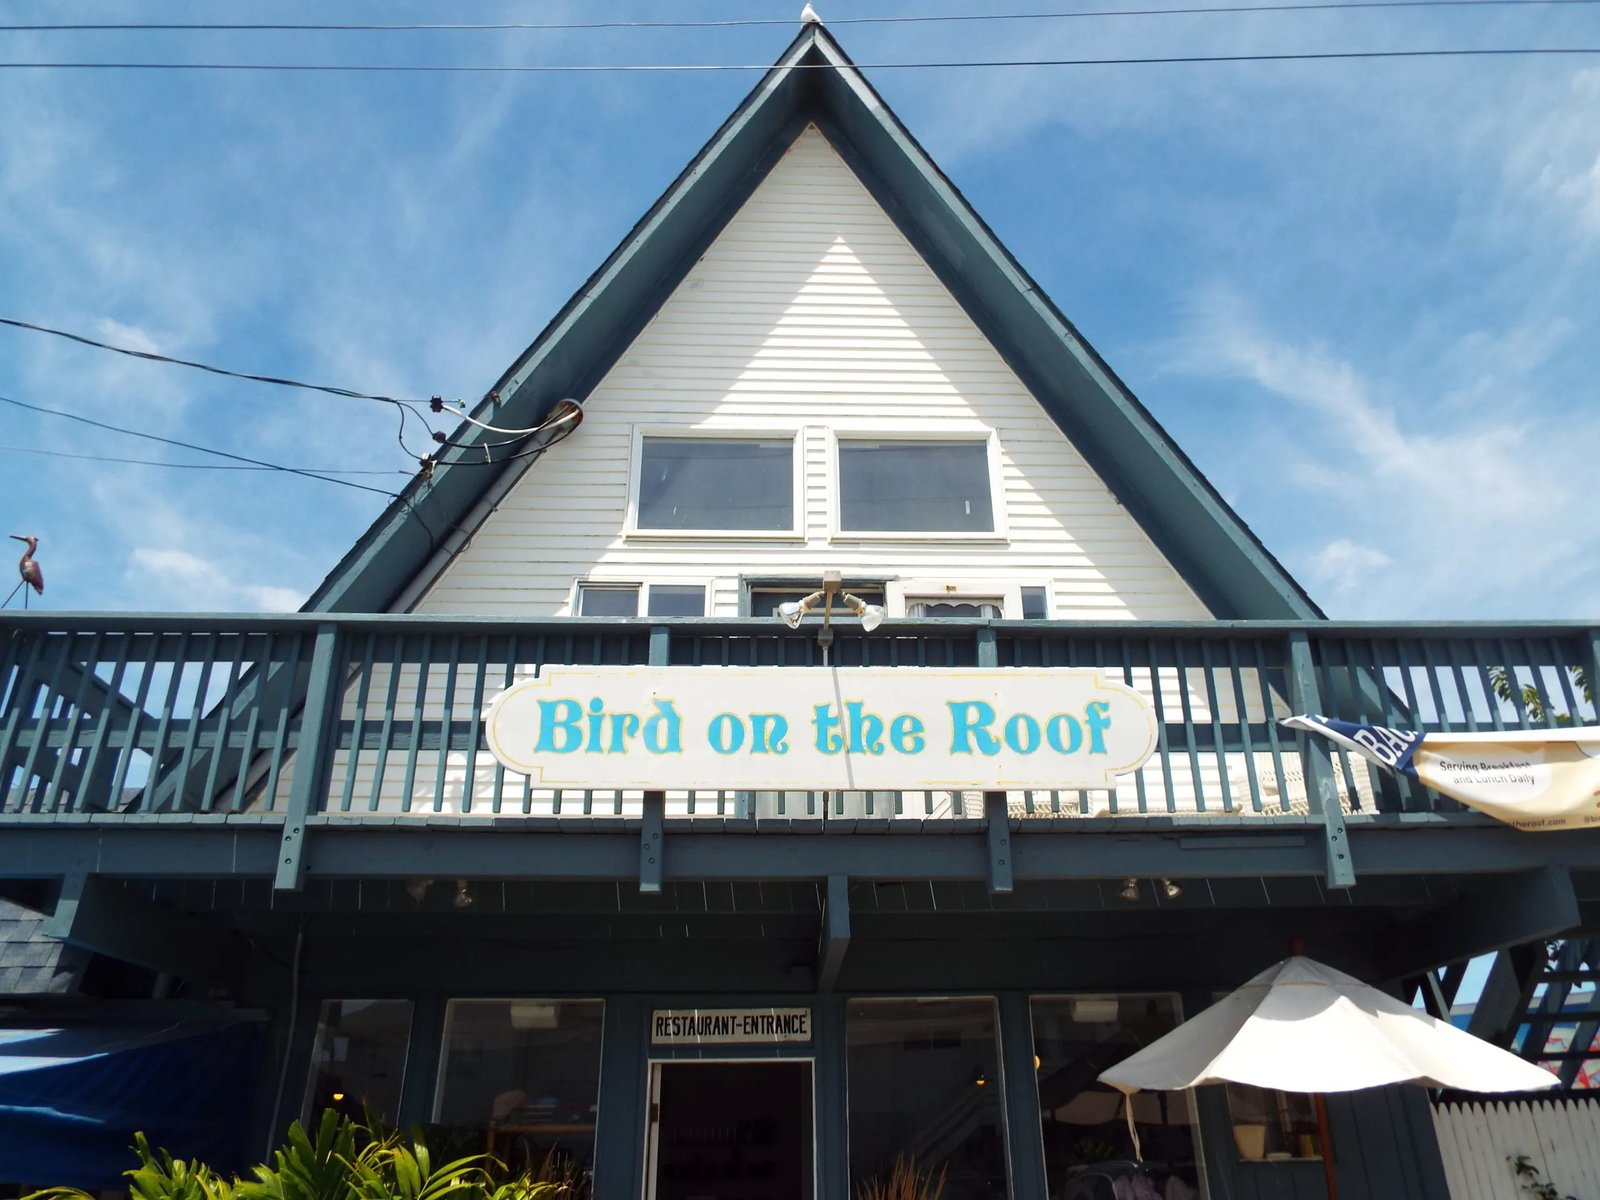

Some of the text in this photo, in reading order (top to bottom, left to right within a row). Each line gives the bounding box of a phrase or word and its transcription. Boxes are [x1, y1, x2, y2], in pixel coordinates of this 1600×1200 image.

[533, 697, 1113, 757] Bird on the Roof
[1353, 725, 1419, 766] BAC
[1439, 760, 1532, 773] Serving Breakfast
[1453, 774, 1535, 785] and Lunch Daily
